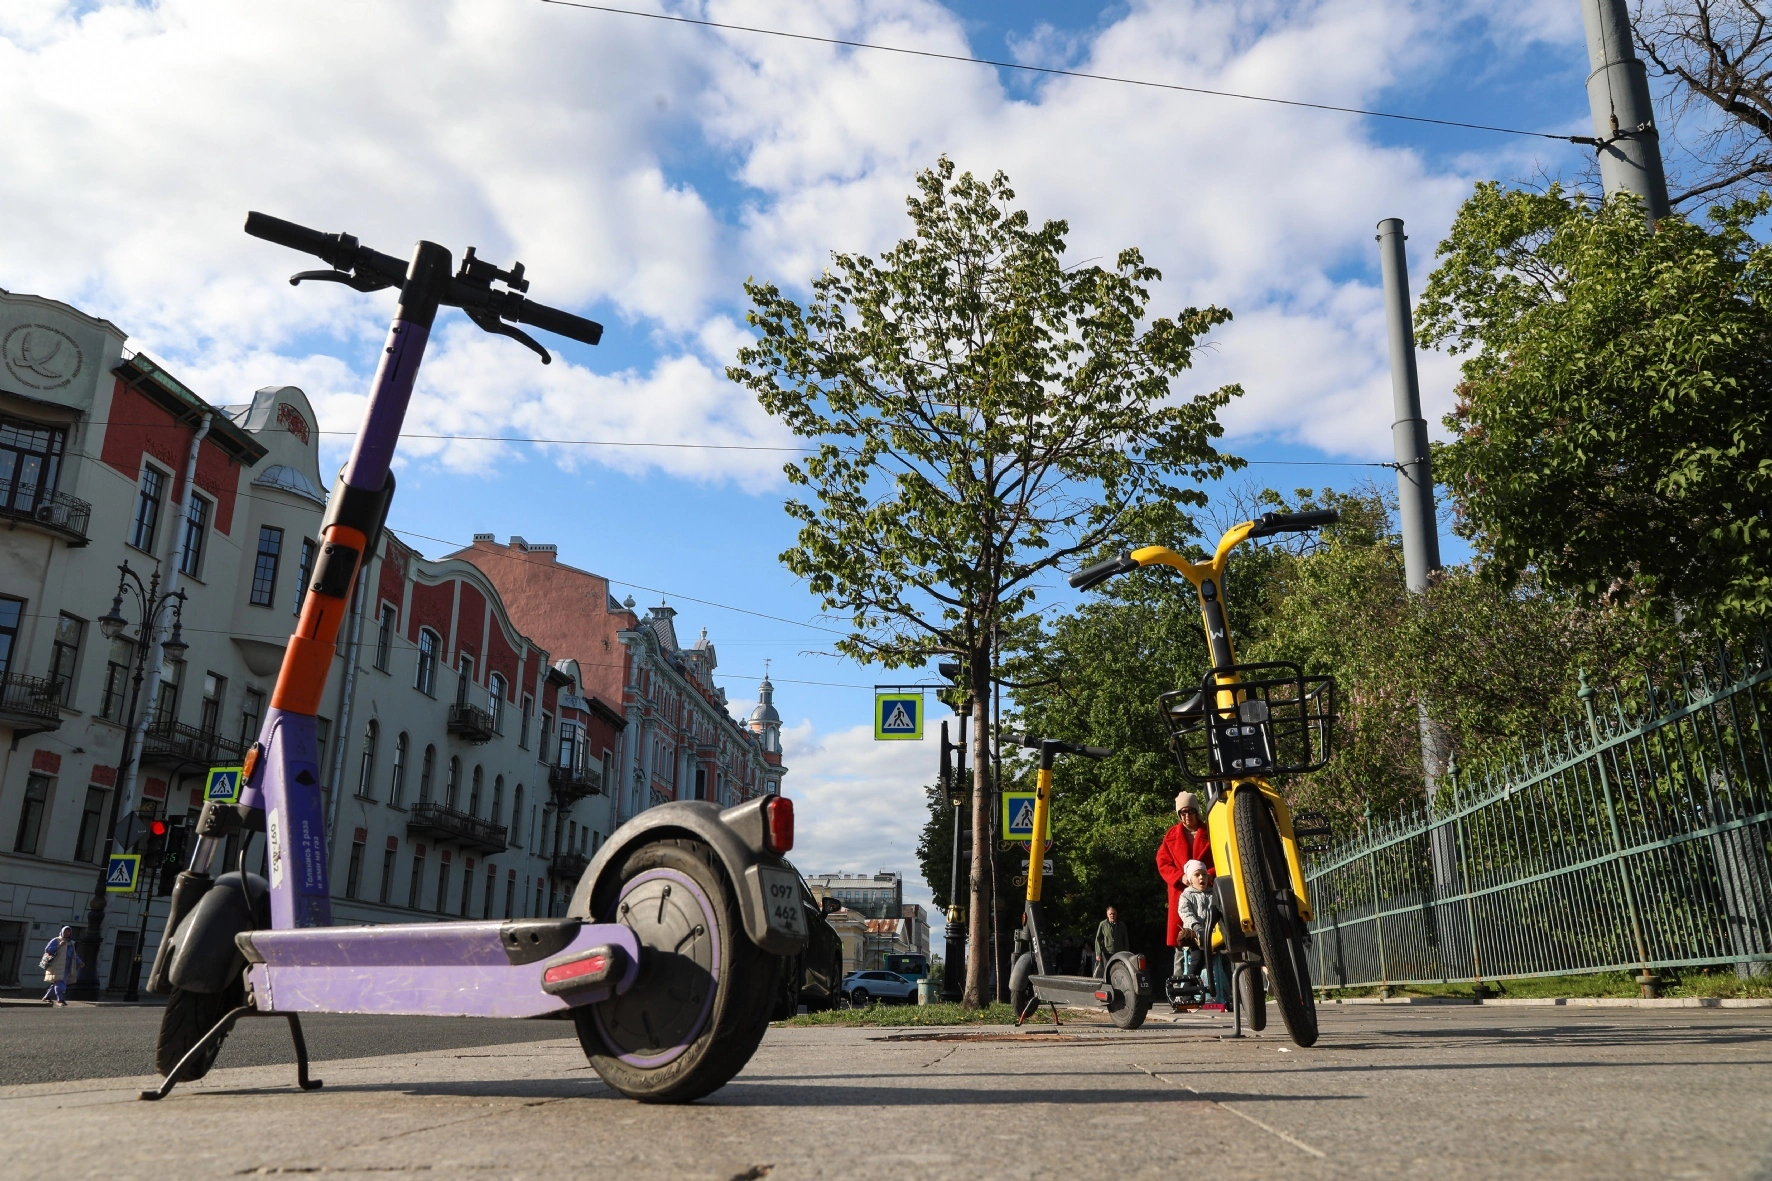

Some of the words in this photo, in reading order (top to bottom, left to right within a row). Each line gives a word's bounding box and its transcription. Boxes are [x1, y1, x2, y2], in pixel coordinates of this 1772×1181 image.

[303, 821, 312, 839] раза
[315, 851, 321, 861] на
[305, 848, 314, 888] Толкнись
[770, 884, 793, 899] 097
[774, 905, 797, 920] 462
